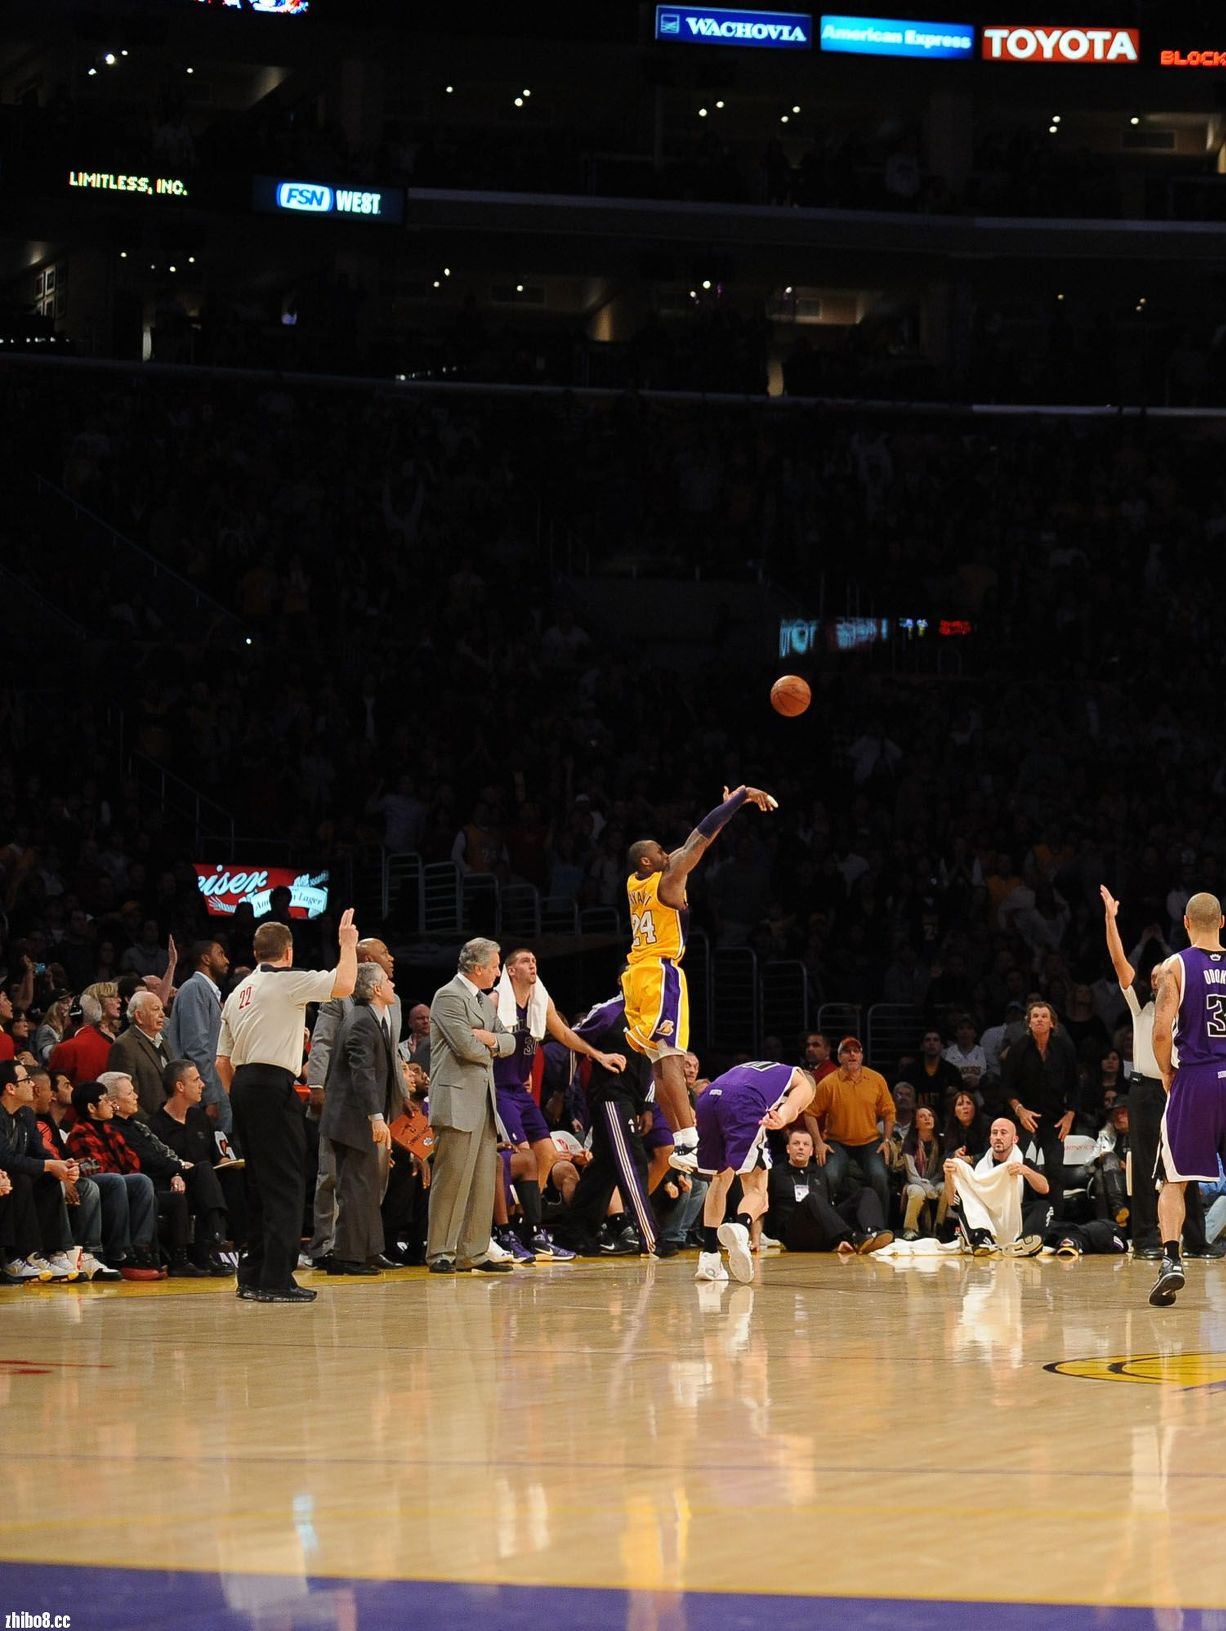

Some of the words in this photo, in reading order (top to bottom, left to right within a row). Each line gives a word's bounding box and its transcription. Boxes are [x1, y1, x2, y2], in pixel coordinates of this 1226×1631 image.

[685, 17, 807, 42] WACHOVIA
[821, 24, 903, 44] American
[904, 29, 972, 49] Express
[984, 28, 1138, 61] TOYOTA
[69, 171, 153, 195] LIMITLESS,
[156, 179, 188, 196] INC.
[285, 187, 325, 207] FSN
[336, 189, 381, 215] WEST
[632, 910, 658, 946] 24
[239, 986, 252, 1010] 22
